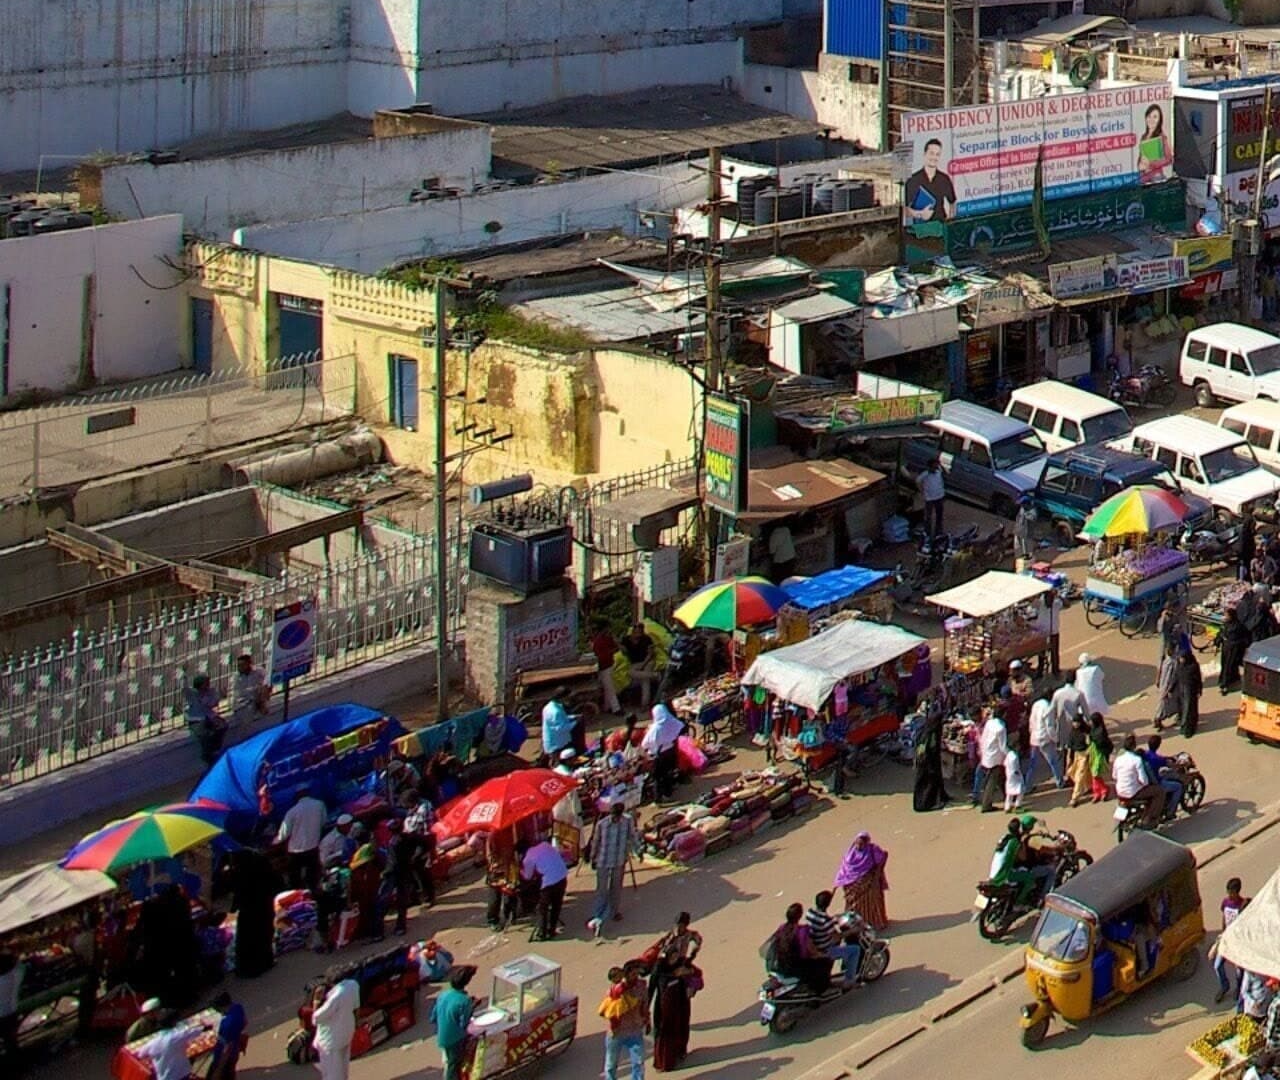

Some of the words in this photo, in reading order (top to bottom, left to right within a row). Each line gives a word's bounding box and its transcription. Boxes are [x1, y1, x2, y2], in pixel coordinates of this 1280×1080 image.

[907, 107, 993, 134] PRESIDENCY
[1048, 100, 1057, 114] &
[1062, 93, 1112, 113] DEGREE
[1116, 86, 1169, 104] COLLEGE
[959, 139, 1008, 154] Separate
[1010, 132, 1041, 146] Block
[1043, 130, 1058, 141] for
[1062, 127, 1088, 139] Boys
[1089, 124, 1097, 134] &
[1101, 120, 1125, 132] Girls
[706, 449, 733, 482] PEARLS
